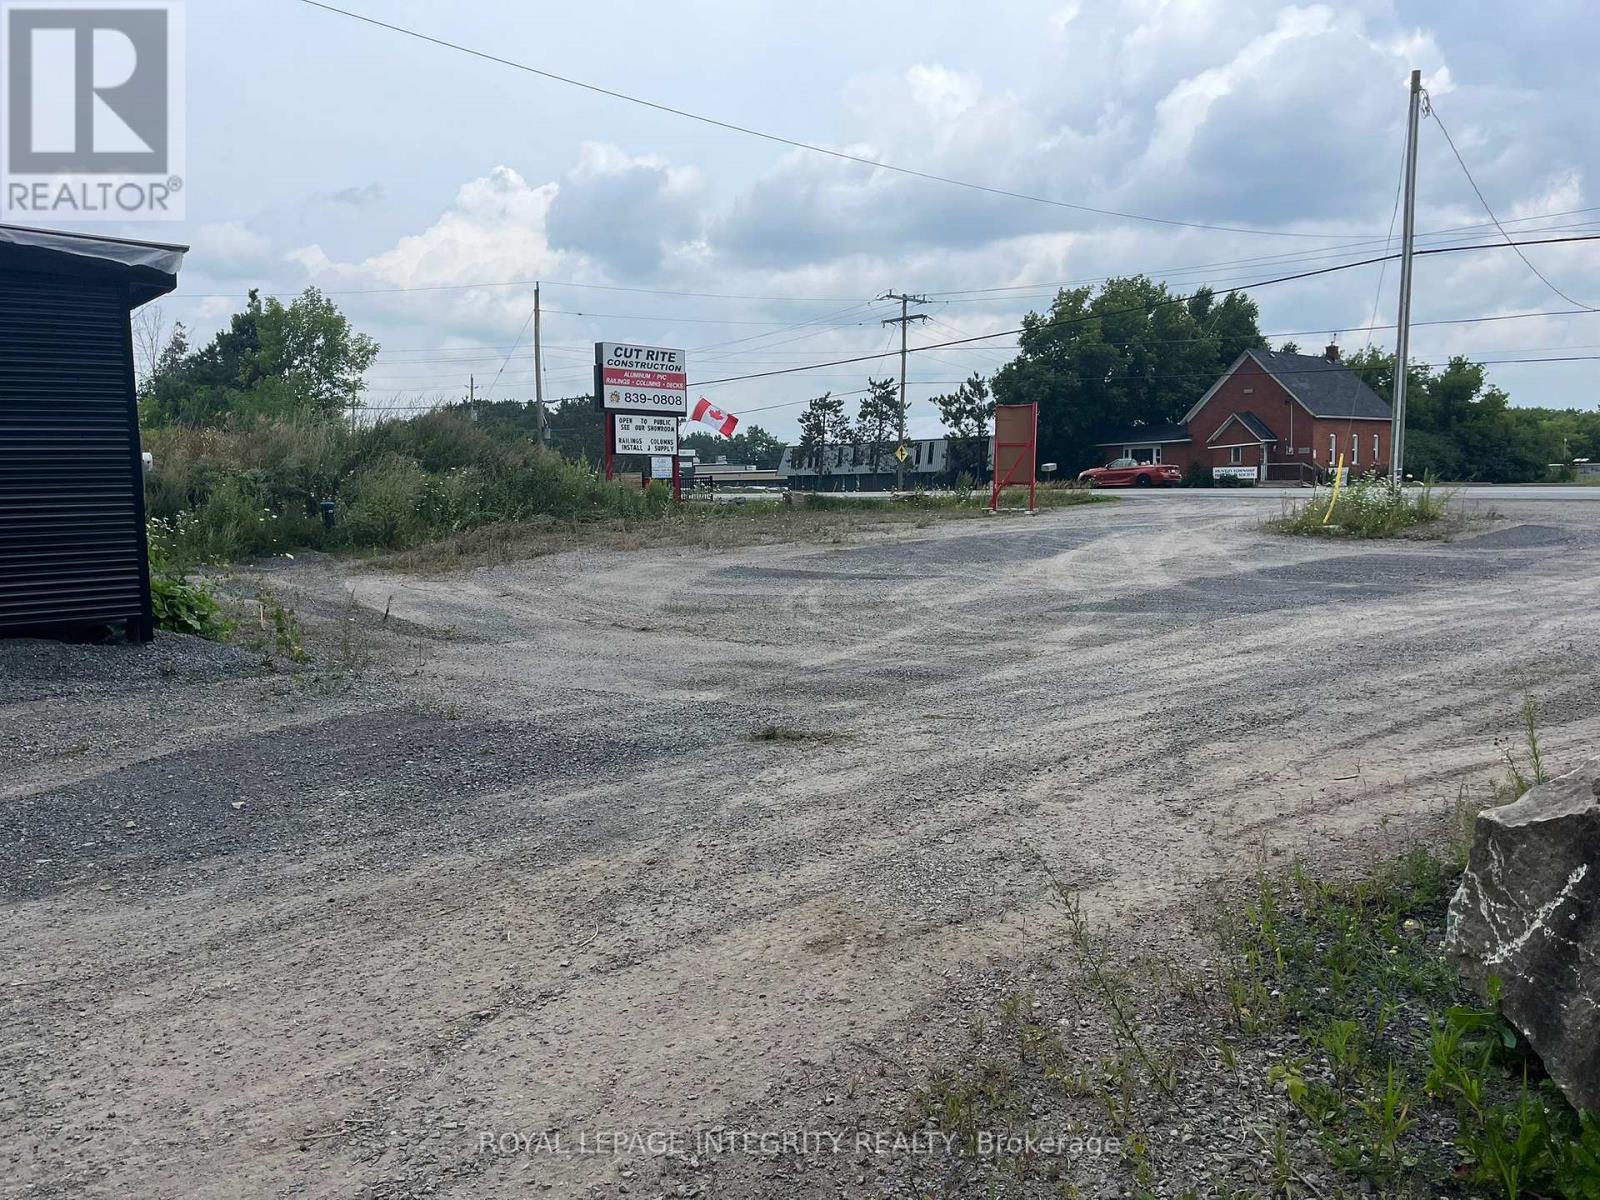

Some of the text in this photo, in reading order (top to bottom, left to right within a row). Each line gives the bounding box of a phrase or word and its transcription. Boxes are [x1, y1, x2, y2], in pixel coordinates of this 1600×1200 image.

[614, 346, 676, 362] CUT RITE
[607, 358, 682, 372] CONSTRUCTION
[606, 377, 630, 385] RAILINGS
[636, 380, 661, 388] COLUMNS
[624, 392, 682, 406] 839-0808
